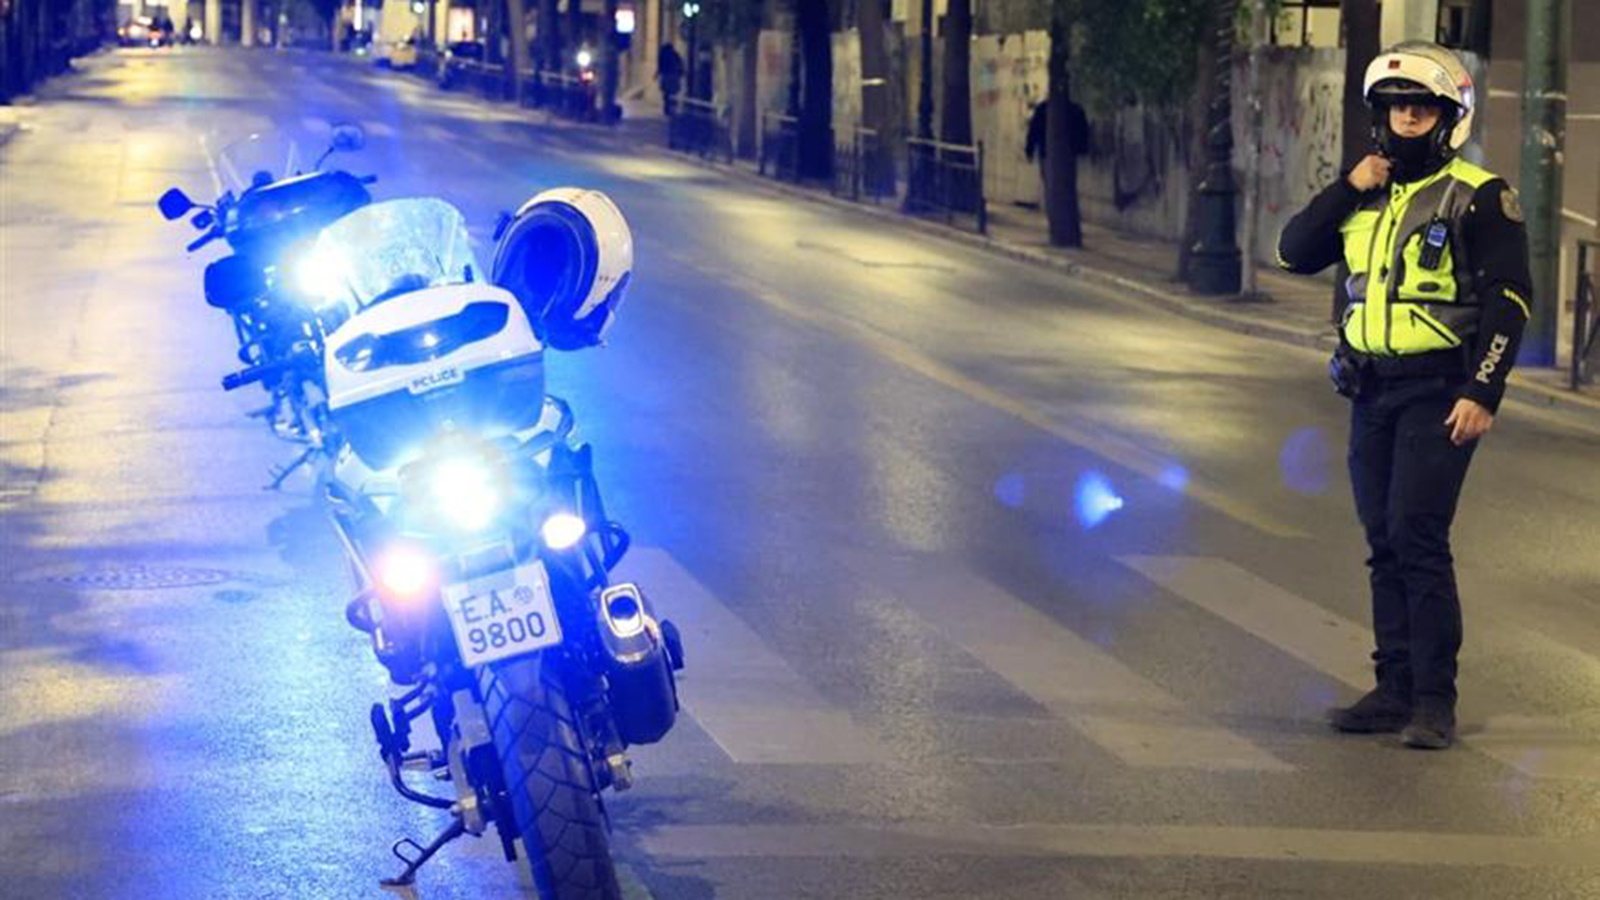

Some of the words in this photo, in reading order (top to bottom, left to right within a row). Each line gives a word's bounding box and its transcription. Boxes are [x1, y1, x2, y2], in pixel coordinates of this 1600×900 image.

[411, 367, 459, 390] POLICE
[1475, 333, 1510, 384] POLICE
[467, 611, 546, 654] 9800
